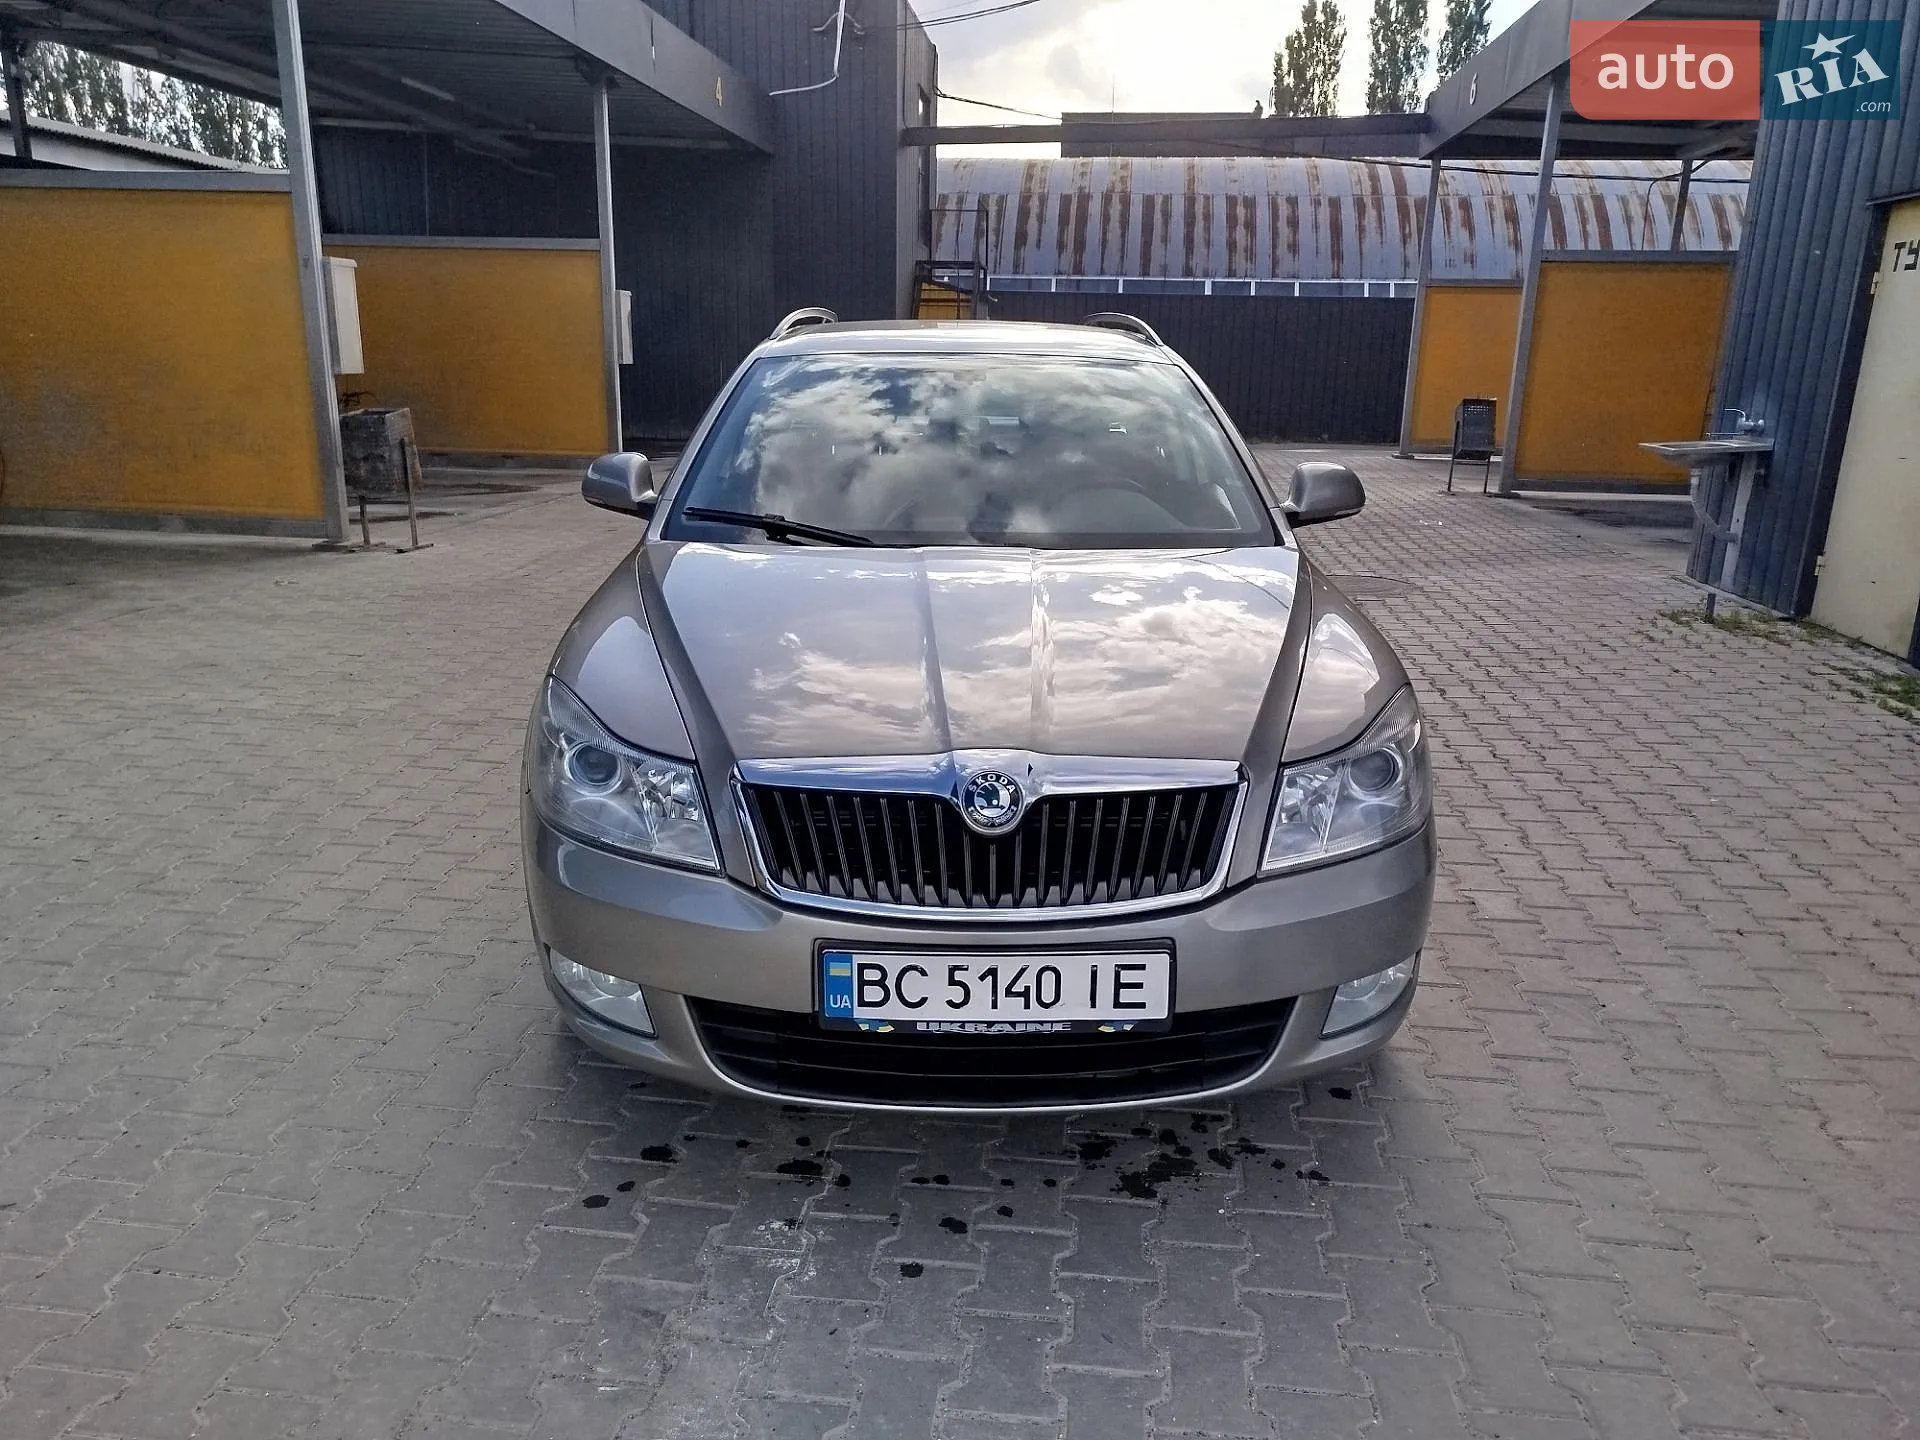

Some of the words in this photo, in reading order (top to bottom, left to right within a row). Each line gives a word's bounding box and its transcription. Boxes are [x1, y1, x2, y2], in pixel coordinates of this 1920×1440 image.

[715, 75, 723, 107] 4
[1469, 72, 1478, 105] 6
[829, 994, 851, 1009] UA
[857, 962, 929, 1009] BC
[945, 963, 1062, 1010] 5140
[1089, 963, 1147, 1009] IE
[916, 1021, 1072, 1033] UKRAINE
